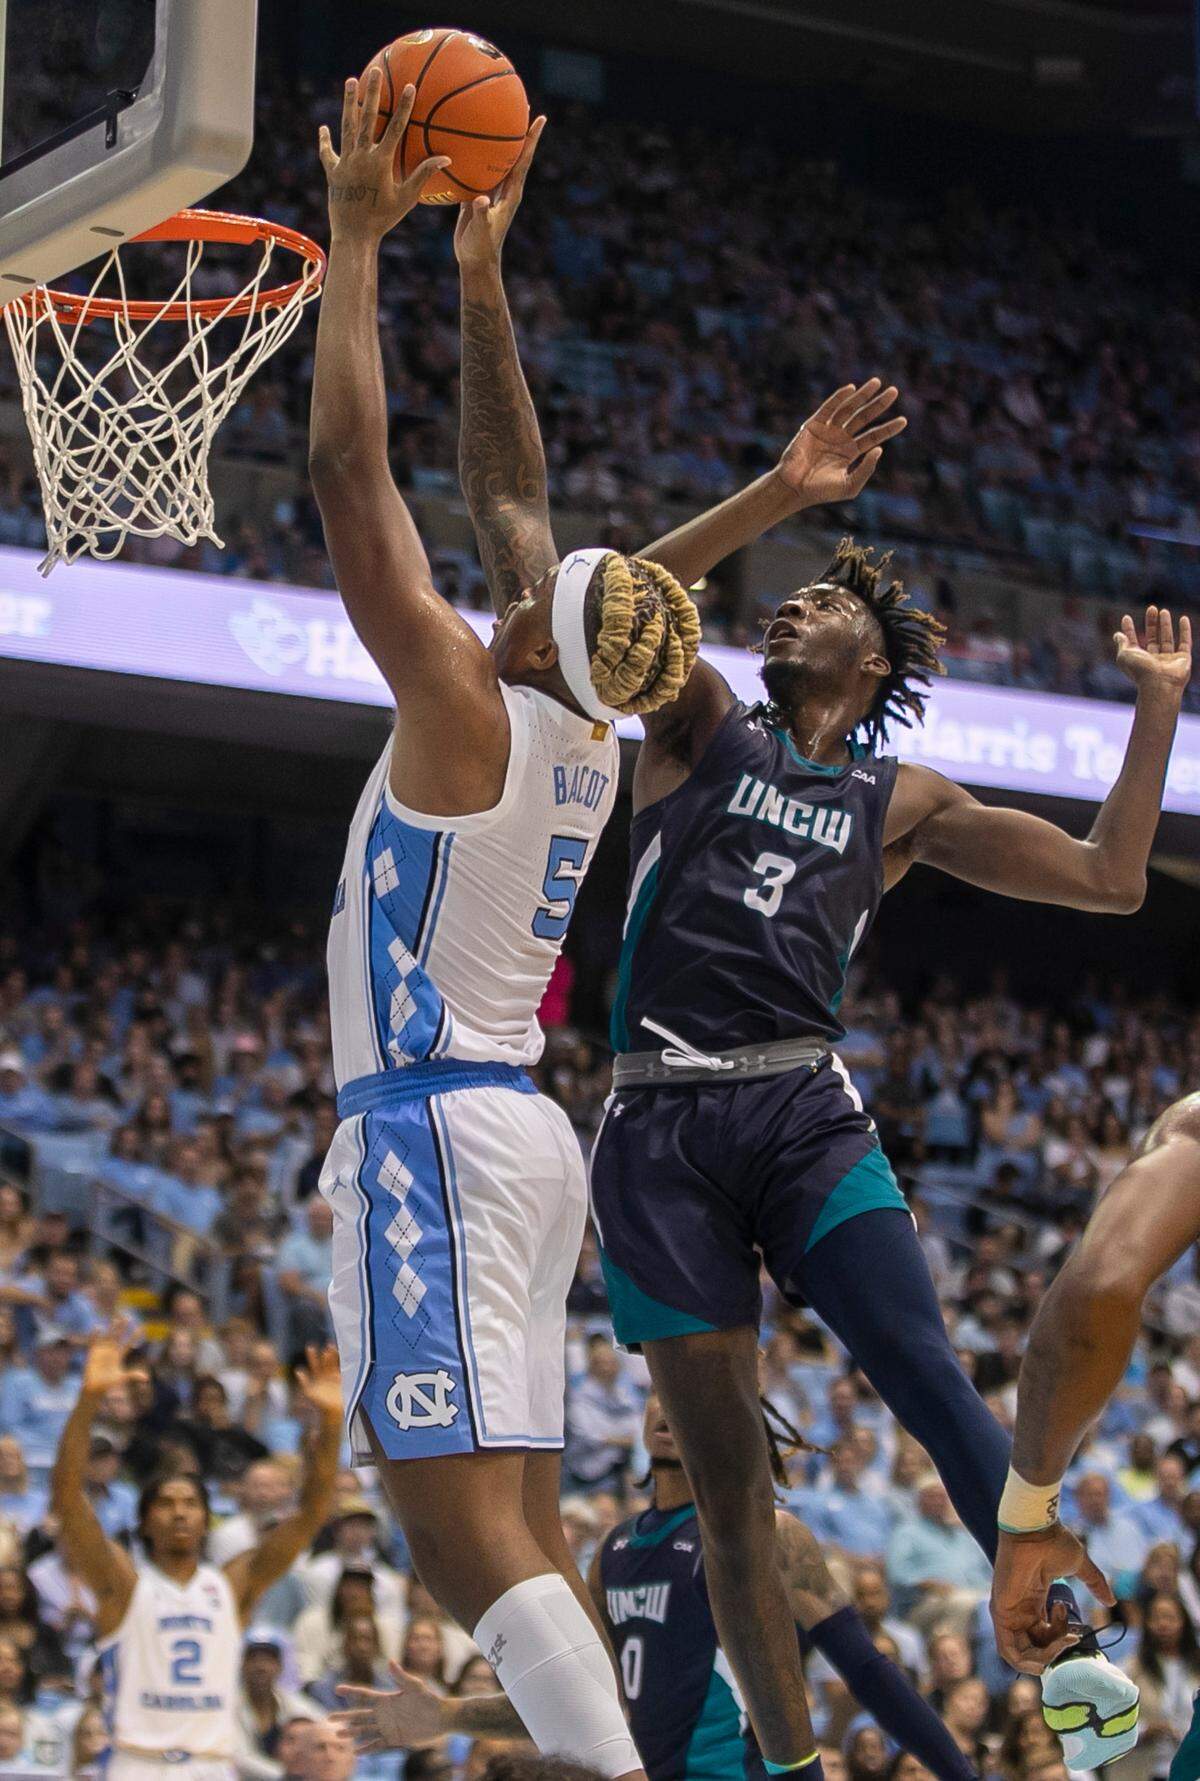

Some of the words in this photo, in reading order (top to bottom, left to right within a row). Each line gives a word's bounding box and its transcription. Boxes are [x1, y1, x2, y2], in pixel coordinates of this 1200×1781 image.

[553, 765, 609, 812] BACOT
[851, 769, 876, 785] CAA
[726, 773, 853, 855] UNCW
[531, 834, 589, 941] 5
[743, 851, 797, 918] 3
[605, 1580, 672, 1626] UNCW
[171, 1640, 203, 1685] 2
[620, 1635, 643, 1701] 0
